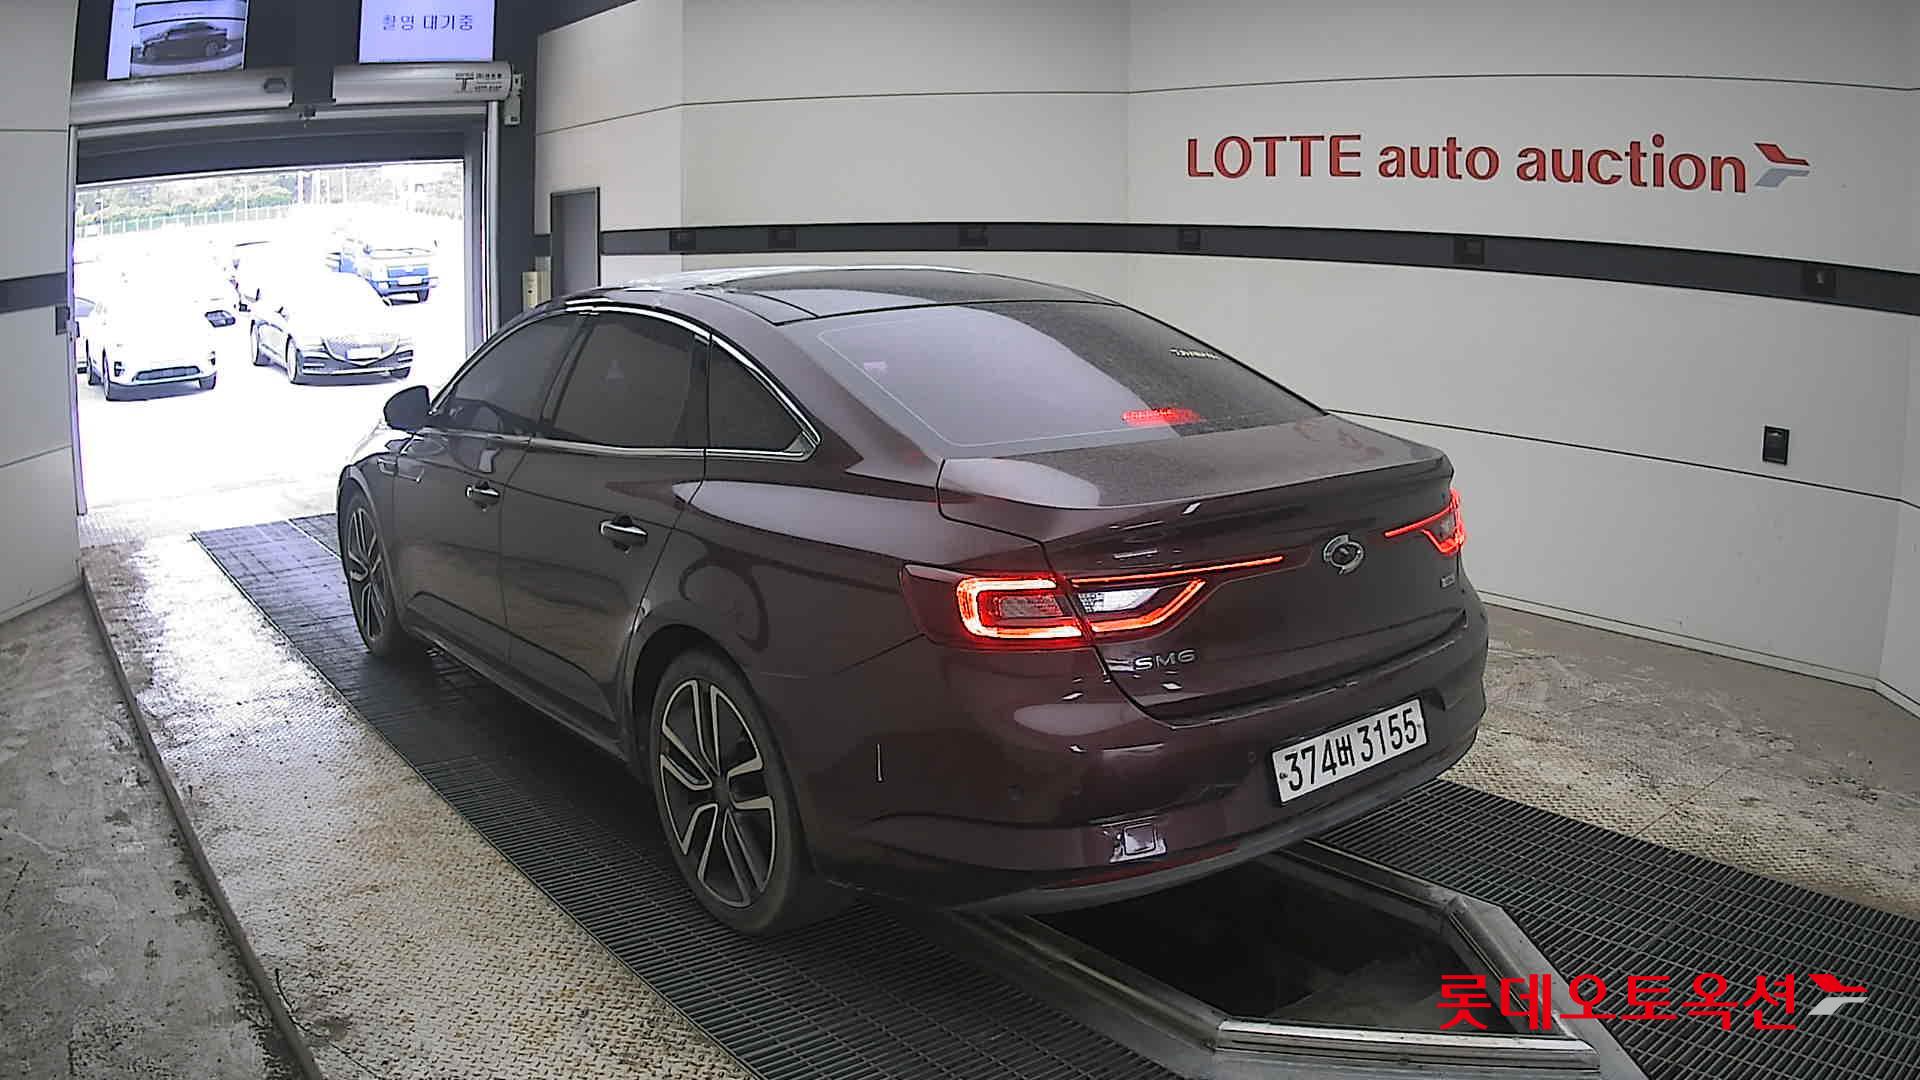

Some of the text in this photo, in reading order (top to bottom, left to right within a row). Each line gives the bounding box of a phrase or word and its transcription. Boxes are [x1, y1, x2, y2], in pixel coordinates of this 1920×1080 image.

[420, 14, 473, 31] 대기중
[1187, 135, 1747, 193] LOTTE auto auction
[1134, 648, 1195, 670] SM6
